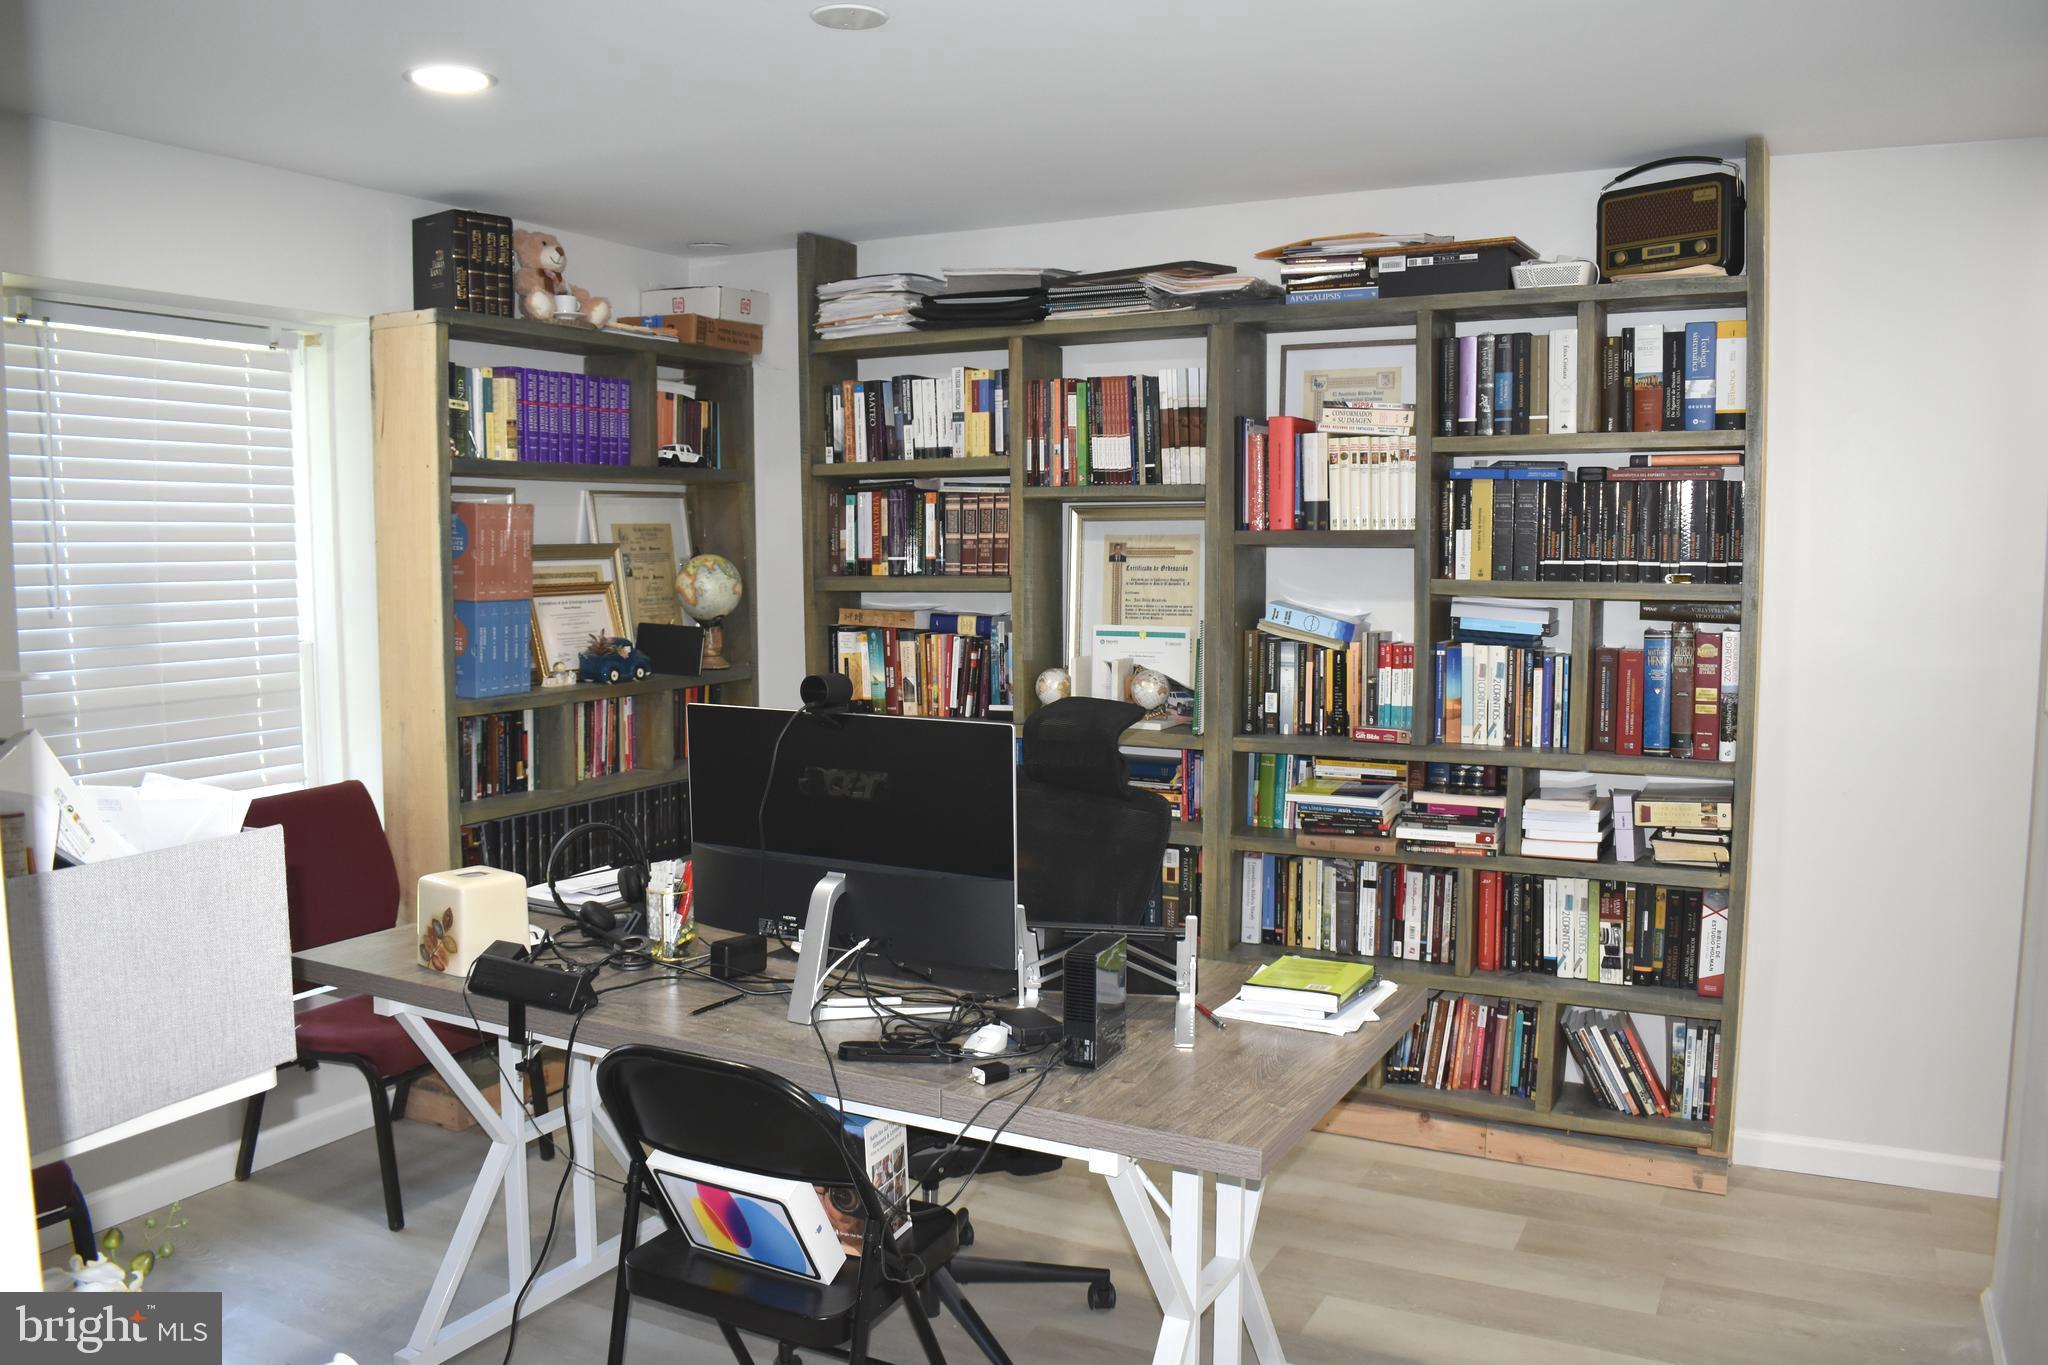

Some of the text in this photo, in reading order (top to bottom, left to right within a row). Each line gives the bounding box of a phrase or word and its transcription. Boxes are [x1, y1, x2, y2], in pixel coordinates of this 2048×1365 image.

[1290, 293, 1341, 303] APOCALIPSIS
[1692, 332, 1700, 372] sistemática
[1697, 336, 1710, 368] Teología
[1724, 636, 1732, 682] PORTAVOZ
[1477, 682, 1486, 720] CORINTIOS
[1493, 684, 1501, 720] CORINTIOS
[1562, 917, 1570, 952] CORINTIOS
[1715, 951, 1721, 959] DE
